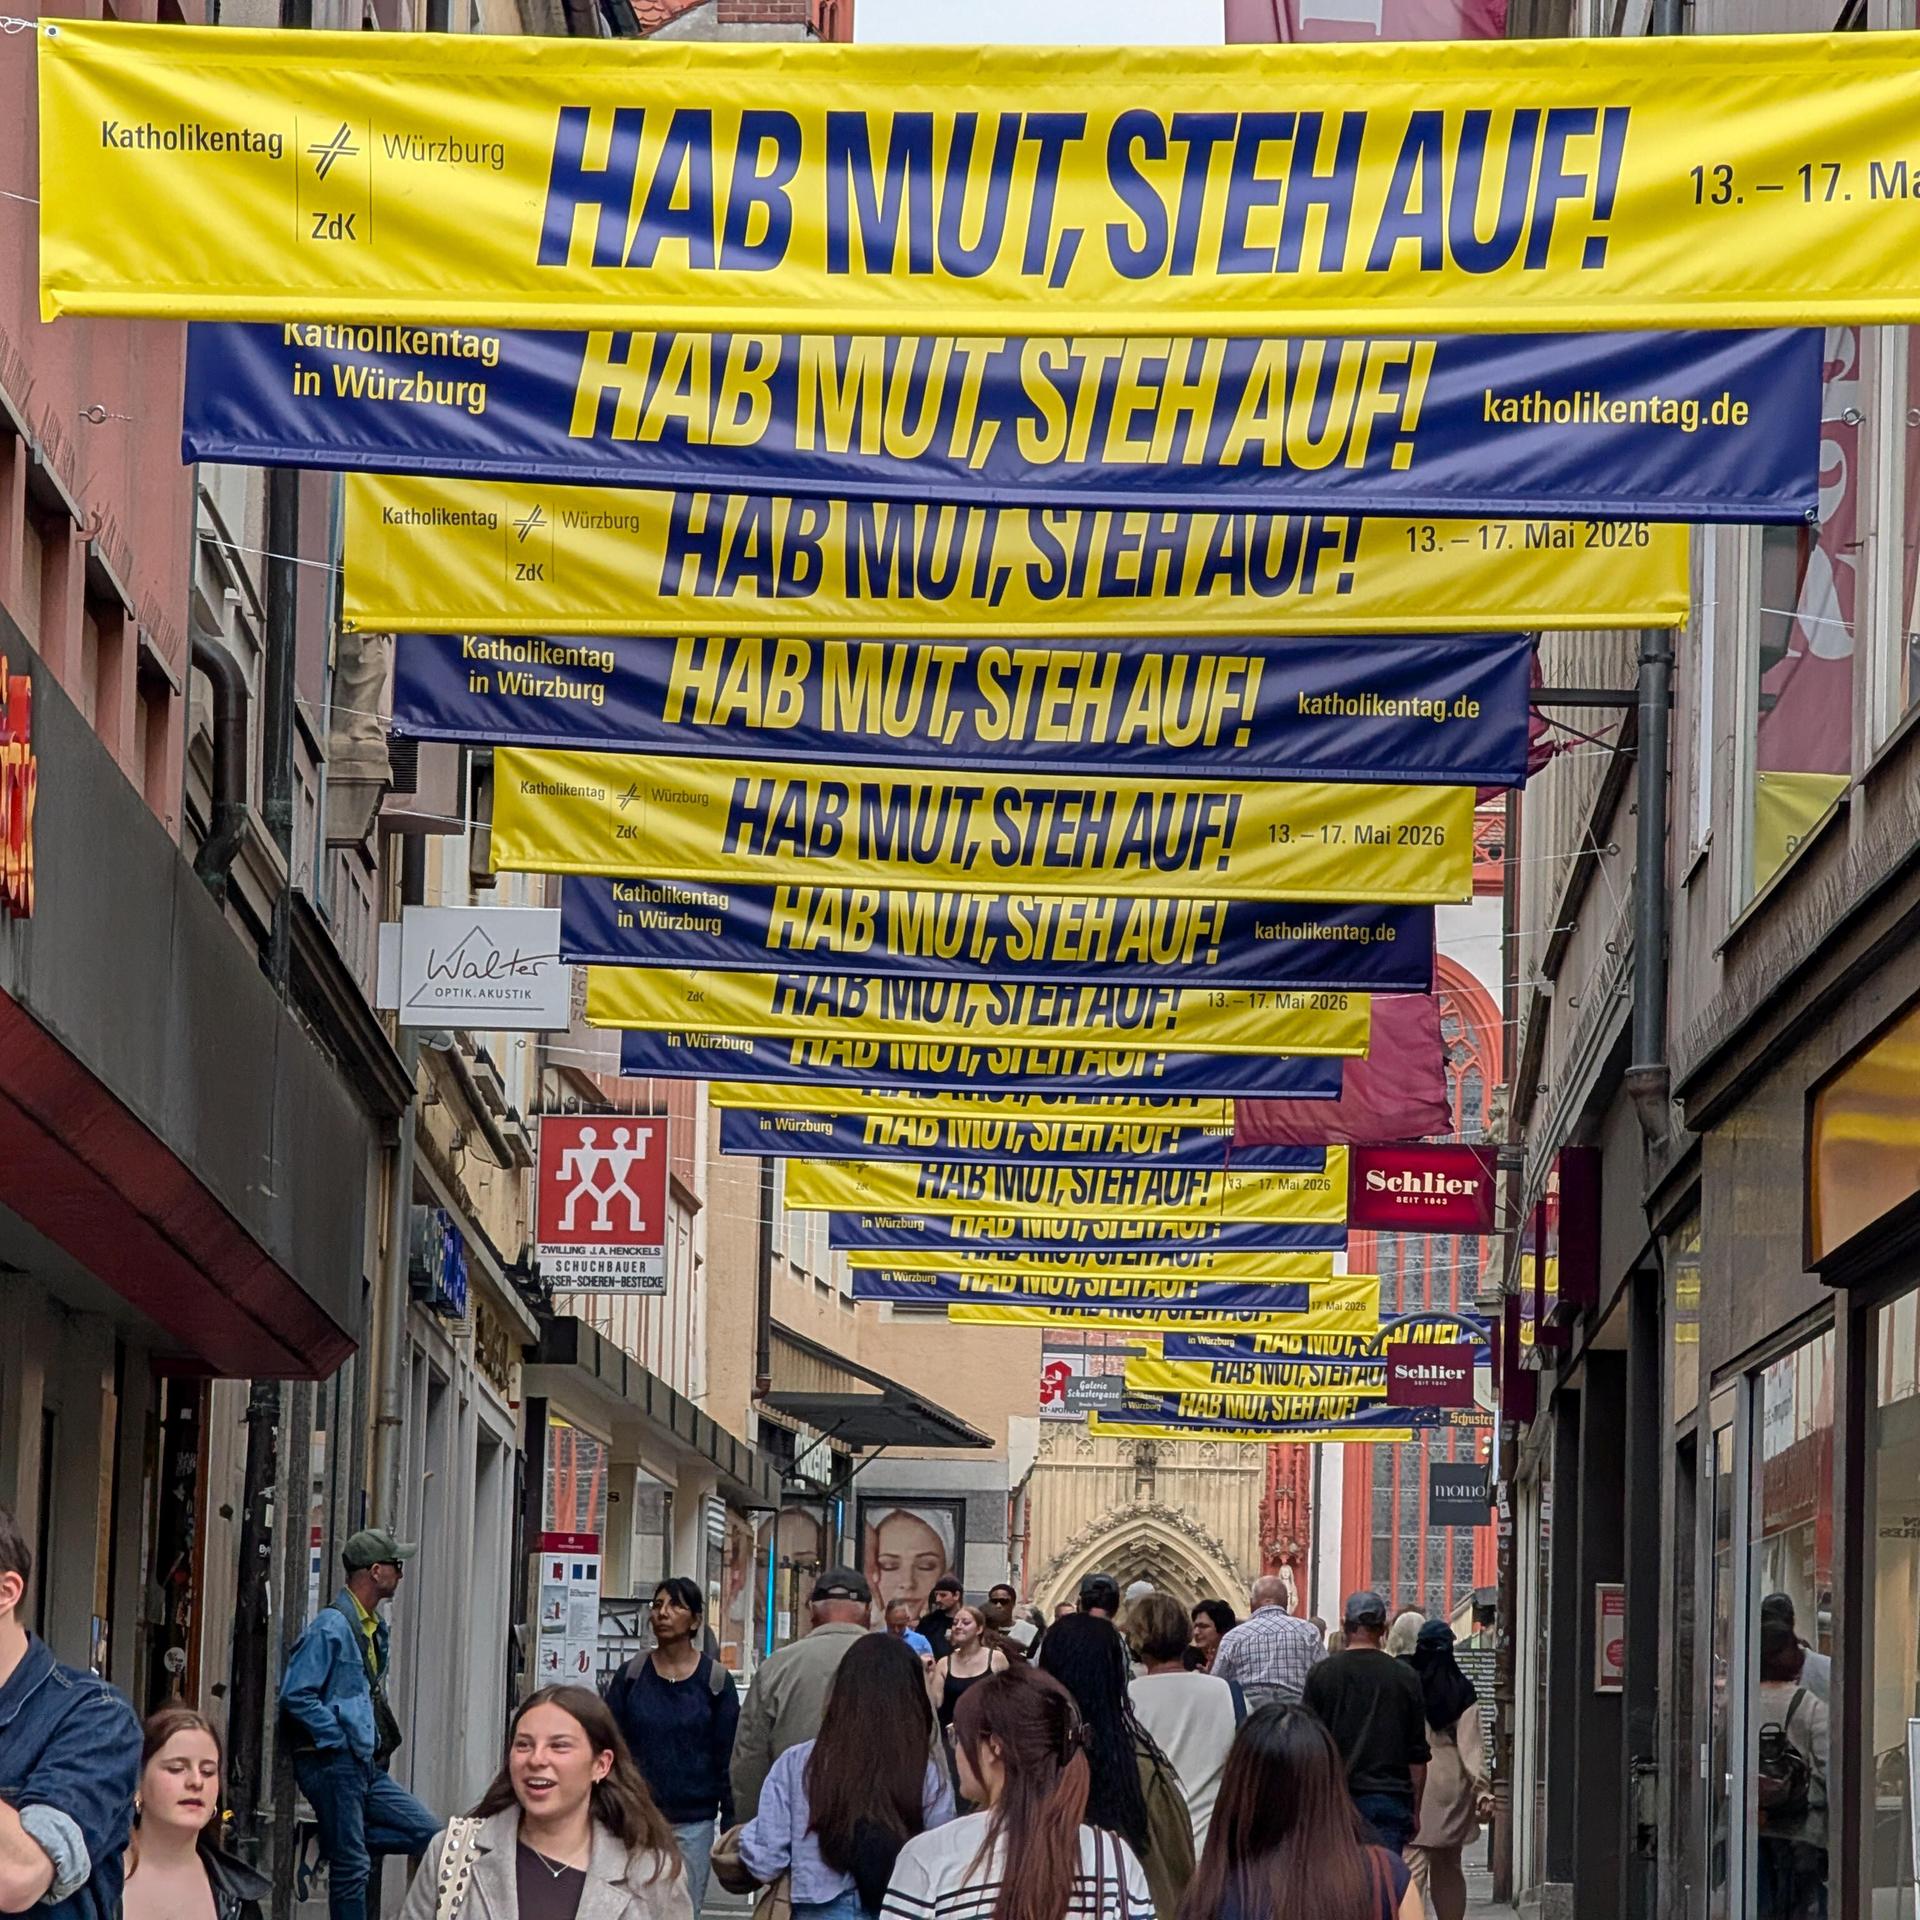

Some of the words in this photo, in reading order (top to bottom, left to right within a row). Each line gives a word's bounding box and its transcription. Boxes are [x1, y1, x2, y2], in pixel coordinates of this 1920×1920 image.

[102, 120, 283, 160] Katholikentag
[383, 133, 505, 170] Würzburg
[536, 105, 802, 271] HAB
[826, 111, 1087, 289] MUT,
[1106, 109, 1367, 280] STEH
[1365, 106, 1632, 274] AUF!
[1690, 164, 1744, 205] 13.
[1798, 163, 1852, 202] 17.
[311, 213, 356, 241] ZdK
[284, 324, 500, 367] Katholikentag
[294, 364, 320, 397] in
[333, 365, 486, 413] Würzburg
[568, 331, 782, 447] HAB
[795, 334, 1003, 469] MUT,
[1015, 337, 1227, 465] STEH
[1219, 341, 1438, 470] AUF!
[1483, 389, 1750, 433] katholikentag.de
[382, 507, 498, 530] Katholikentag
[562, 510, 640, 532] Würzburg
[658, 491, 830, 599] HAB
[1190, 513, 1361, 597] AUF!
[1406, 526, 1444, 553] 13.
[1479, 524, 1514, 551] 17.
[1525, 522, 1575, 549] Mai
[1584, 522, 1650, 548] 2026
[515, 563, 544, 582] ZdK
[462, 636, 615, 673] Katholikentag
[469, 670, 489, 693] in
[497, 671, 605, 706] Würzburg
[662, 637, 811, 729] HAB
[821, 641, 968, 745] MUT,
[974, 645, 1121, 743] STEH
[1117, 653, 1266, 749] AUF!
[1298, 691, 1480, 723] katholikentag.de
[520, 780, 606, 801] Katholikentag
[651, 788, 709, 806] Würzburg
[721, 777, 848, 859] HAB
[858, 783, 985, 870] MUT,
[991, 786, 1118, 869] STEH
[1115, 791, 1243, 872] AUF!
[1268, 824, 1296, 844] 13.
[1320, 825, 1346, 844] 17.
[1354, 825, 1391, 845] Mai
[1398, 825, 1445, 846] 2026
[612, 882, 729, 909] Katholikentag
[617, 913, 634, 928] in
[640, 911, 722, 937] Würzburg
[766, 886, 882, 953] HAB
[887, 891, 999, 965] MUT,
[1005, 895, 1117, 962] STEH
[1114, 899, 1229, 965] AUF!
[1255, 921, 1396, 944] katholikentag.de
[428, 948, 562, 980] Walter
[435, 988, 532, 999] OPTIK.AKUSTIK
[1208, 993, 1229, 1008] 13.
[1249, 993, 1270, 1009] 17.
[1275, 993, 1306, 1009] Mai
[1310, 994, 1348, 1010] 2026
[667, 1033, 680, 1047] in
[686, 1033, 753, 1054] Würzburg
[760, 1117, 771, 1130] in
[775, 1118, 833, 1134] Würzburg
[916, 1164, 986, 1200] HAB
[1259, 1178, 1275, 1190] 17.
[1278, 1178, 1299, 1191] Mai
[1303, 1179, 1331, 1191] 2026
[1366, 1170, 1479, 1195] Schlier
[1396, 1196, 1419, 1204] SEIT
[862, 1217, 873, 1228] in
[875, 1217, 924, 1231] Würzburg
[541, 1246, 585, 1254] ZWILLING
[610, 1247, 661, 1256] HENCKELS
[556, 1260, 646, 1273] SCHUCHBAUER
[882, 1271, 891, 1281] in
[892, 1272, 936, 1284] Würzburg
[1395, 1365, 1465, 1379] Schlier
[1080, 1381, 1108, 1390] Galerie
[1178, 1392, 1222, 1418] HAB
[1450, 1412, 1495, 1425] Schuster
